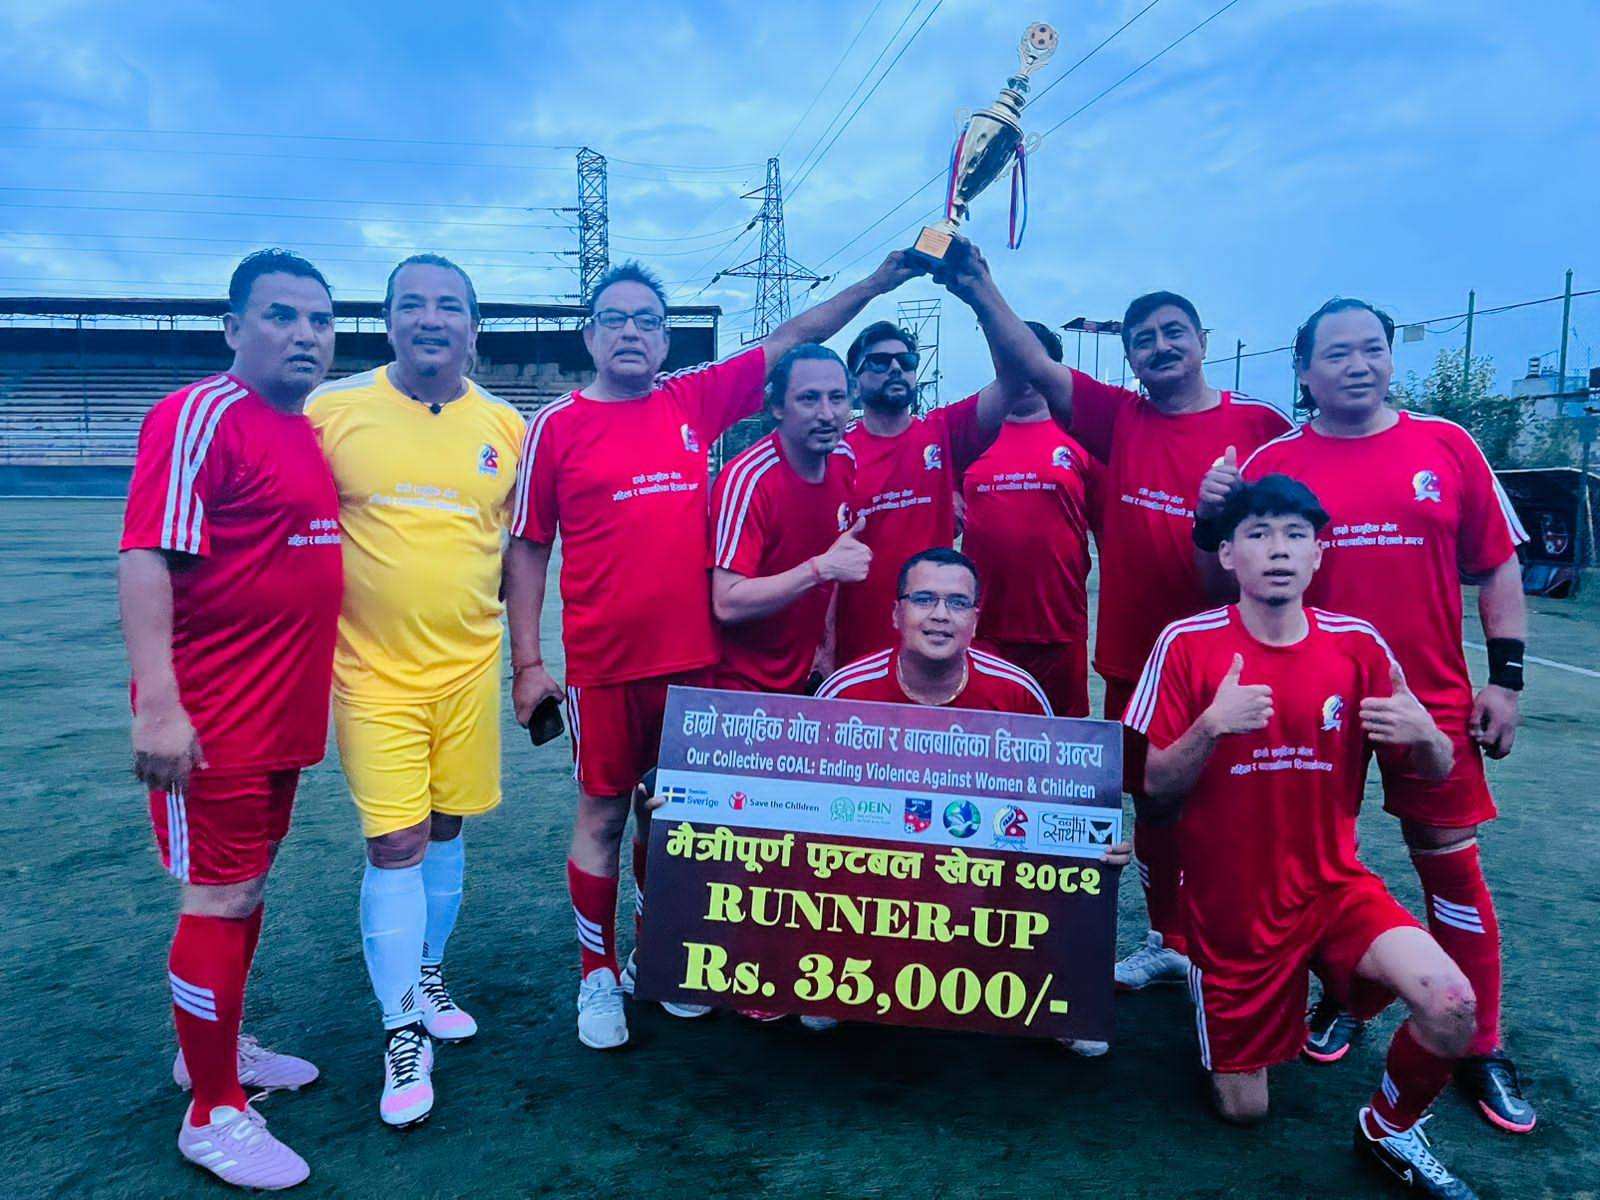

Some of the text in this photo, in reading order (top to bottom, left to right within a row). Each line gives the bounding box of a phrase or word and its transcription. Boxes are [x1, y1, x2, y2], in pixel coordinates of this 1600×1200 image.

[683, 705, 718, 737] हाम्रो
[721, 708, 784, 746] सामूहिक
[787, 712, 821, 744] गोल
[835, 715, 885, 750] महिला
[888, 727, 900, 752] र
[904, 723, 991, 758] बालबालिका
[1056, 742, 1104, 768] अन्त्य
[687, 748, 1096, 799] Our Collective GOAL: Ending Violence Against Women & Children
[687, 796, 719, 807] Sverige
[750, 799, 819, 812] Save the Children
[666, 822, 1100, 895] मैत्रीपूर्ण फुटबल खेल २०८२
[703, 881, 1049, 951] RUNNER-UP
[678, 942, 1068, 1027] Rs. 35,000/-
